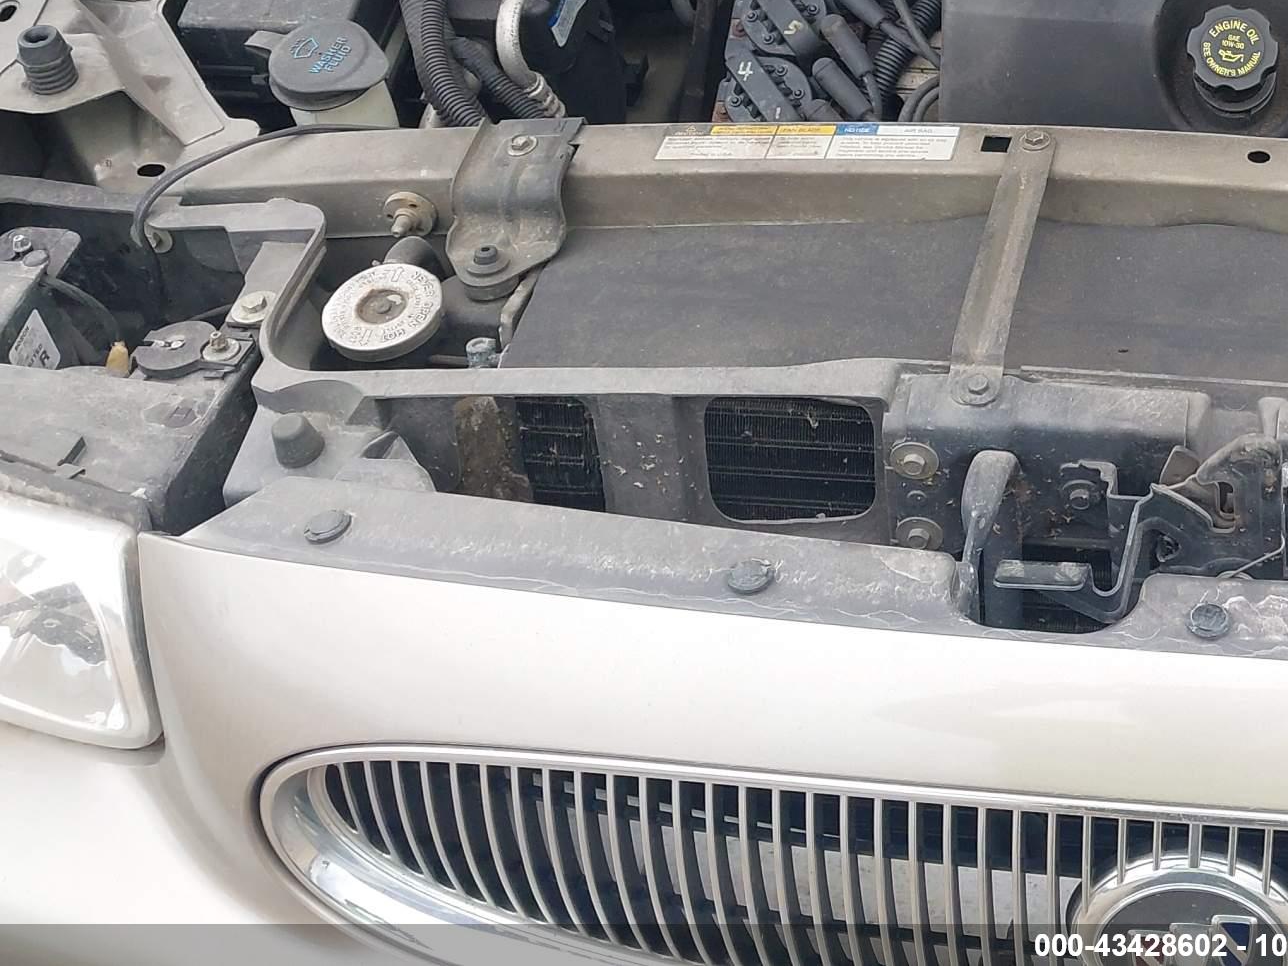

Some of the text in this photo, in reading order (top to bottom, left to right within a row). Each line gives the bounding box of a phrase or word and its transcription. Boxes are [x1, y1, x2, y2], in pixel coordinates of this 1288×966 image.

[784, 20, 803, 35] 5
[1209, 19, 1260, 45] ENGINE OIL
[309, 36, 348, 74] WASHER
[1222, 40, 1245, 49] 10W-30
[324, 45, 352, 72] FLUID
[738, 61, 753, 81] 4
[1202, 42, 1211, 57] SEE
[1237, 51, 1261, 76] MANUAL
